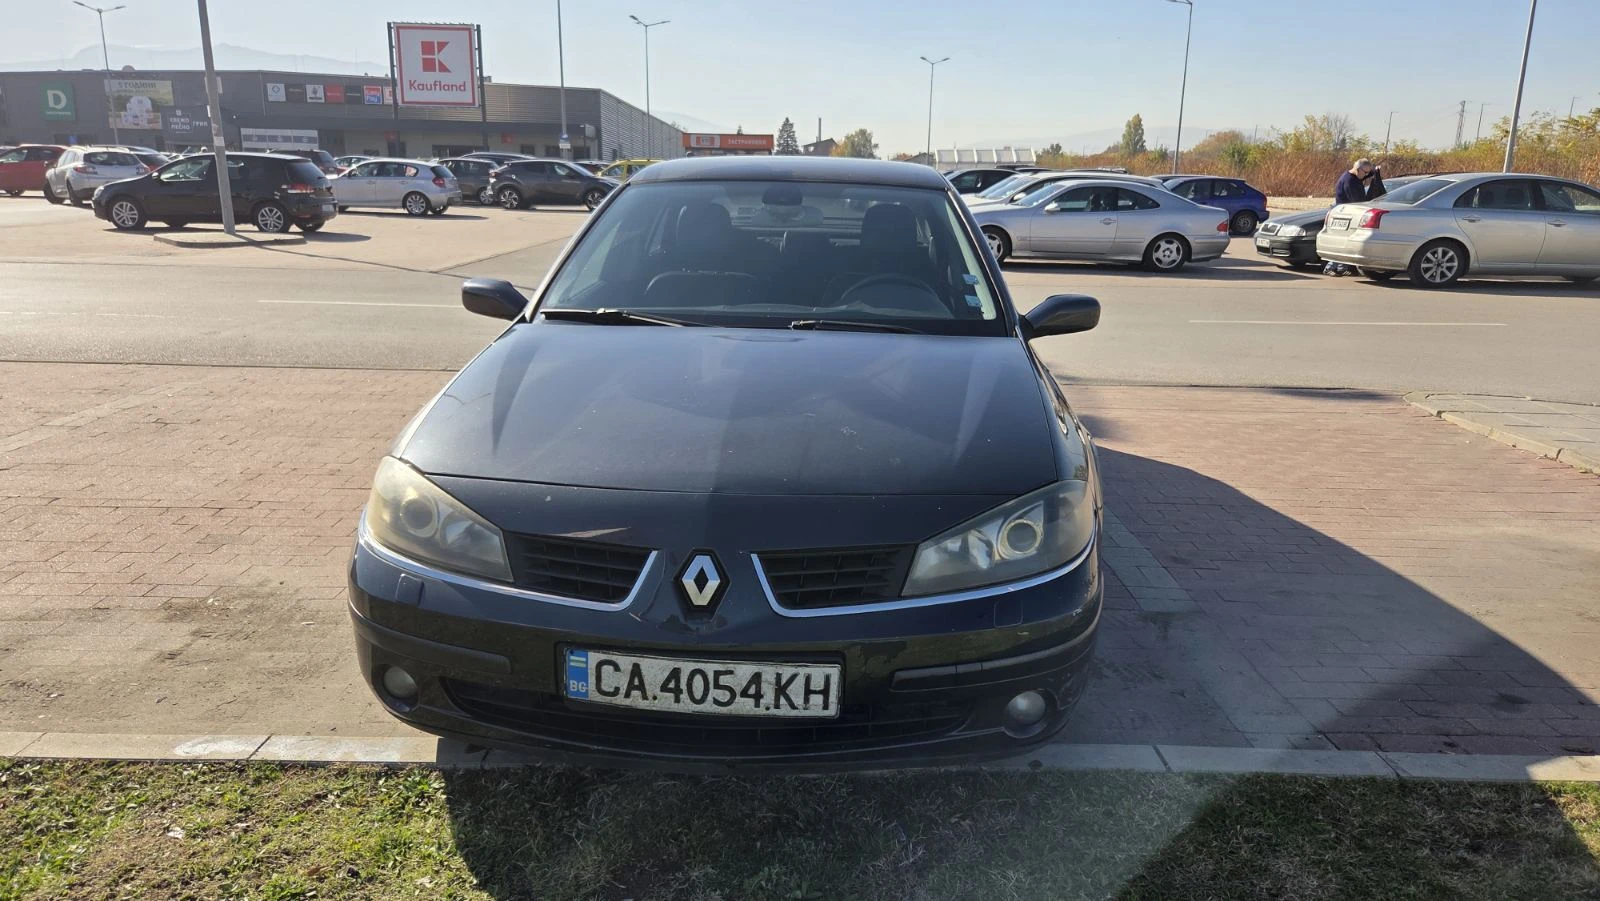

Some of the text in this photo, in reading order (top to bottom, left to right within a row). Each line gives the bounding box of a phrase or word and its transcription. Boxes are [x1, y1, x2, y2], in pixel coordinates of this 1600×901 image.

[408, 79, 467, 92] Kaufland
[47, 89, 67, 109] D
[569, 679, 589, 693] BG
